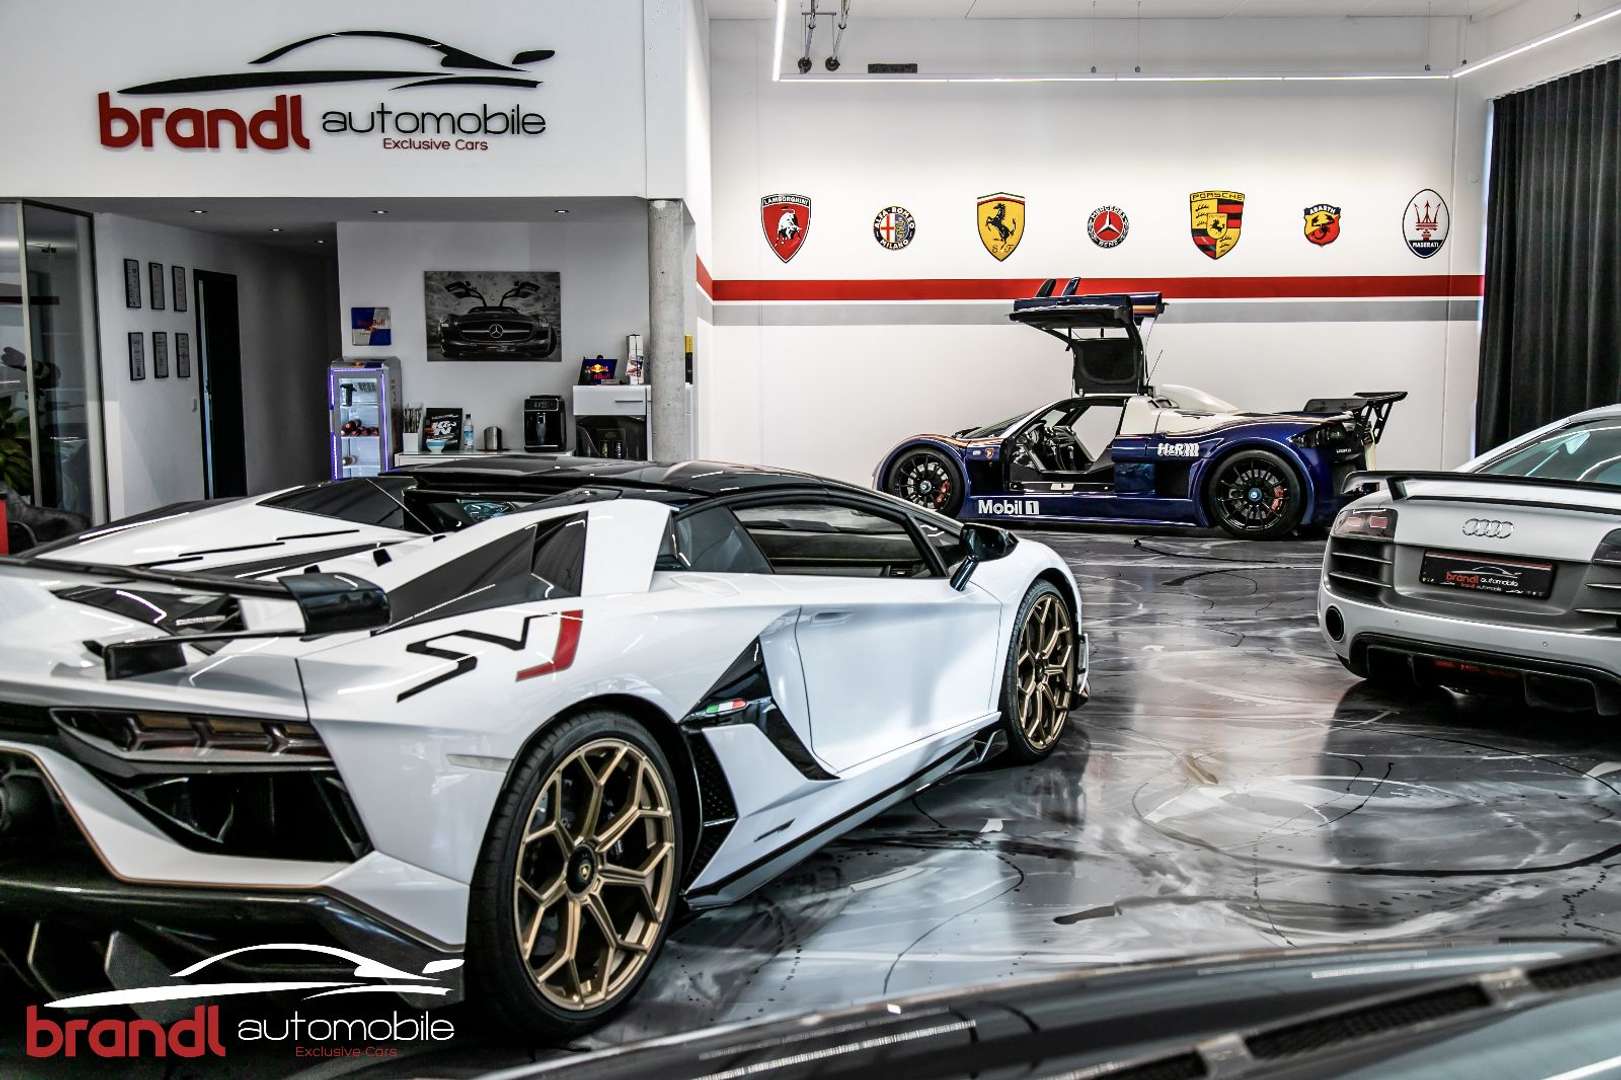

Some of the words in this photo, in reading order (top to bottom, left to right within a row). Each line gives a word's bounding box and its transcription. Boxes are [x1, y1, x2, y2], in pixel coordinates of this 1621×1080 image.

[98, 91, 311, 150] brandl
[321, 102, 546, 136] automobile
[383, 137, 451, 151] Exclusive
[455, 137, 489, 151] Cars
[763, 195, 809, 206] LAMBORGHINI
[1192, 192, 1243, 201] PORSCHE
[978, 499, 1023, 515] Mobil
[1445, 572, 1479, 584] brandl
